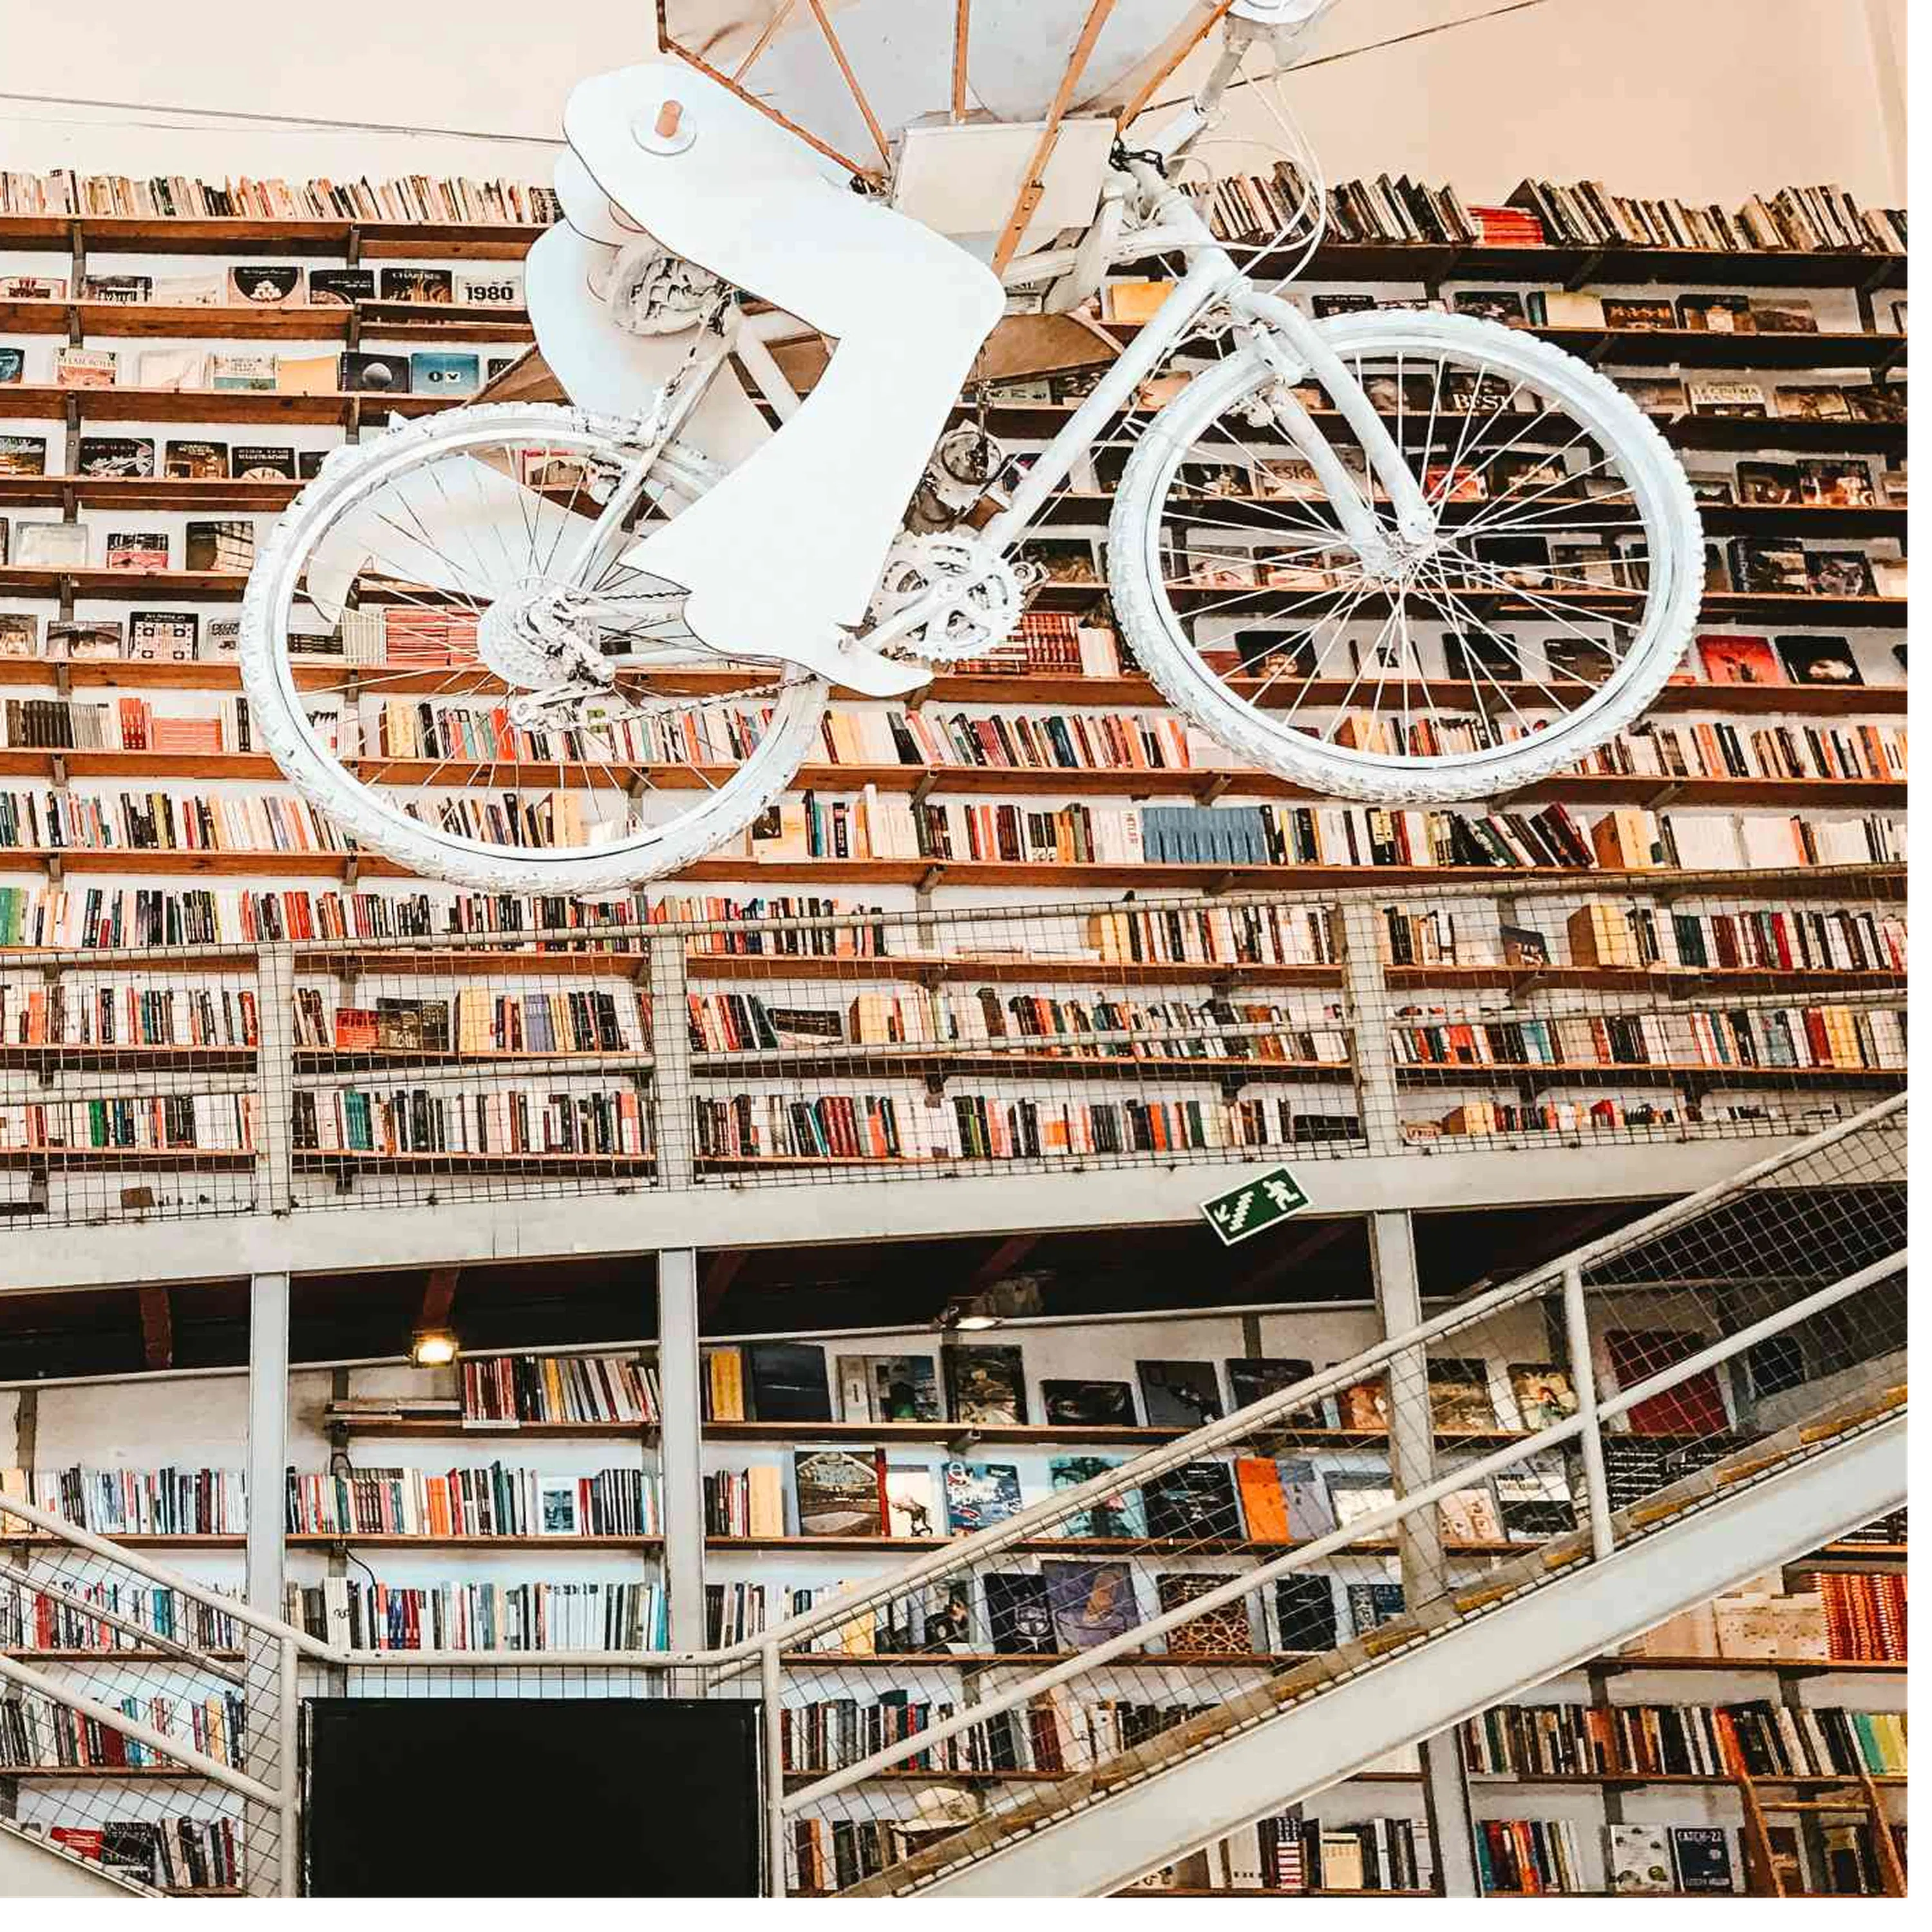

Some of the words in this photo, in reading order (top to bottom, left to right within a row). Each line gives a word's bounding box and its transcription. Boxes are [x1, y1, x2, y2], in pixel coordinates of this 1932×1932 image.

[465, 285, 515, 301] 1980
[1452, 393, 1510, 410] BEST
[1677, 1831, 1723, 1842] CATCH-22
